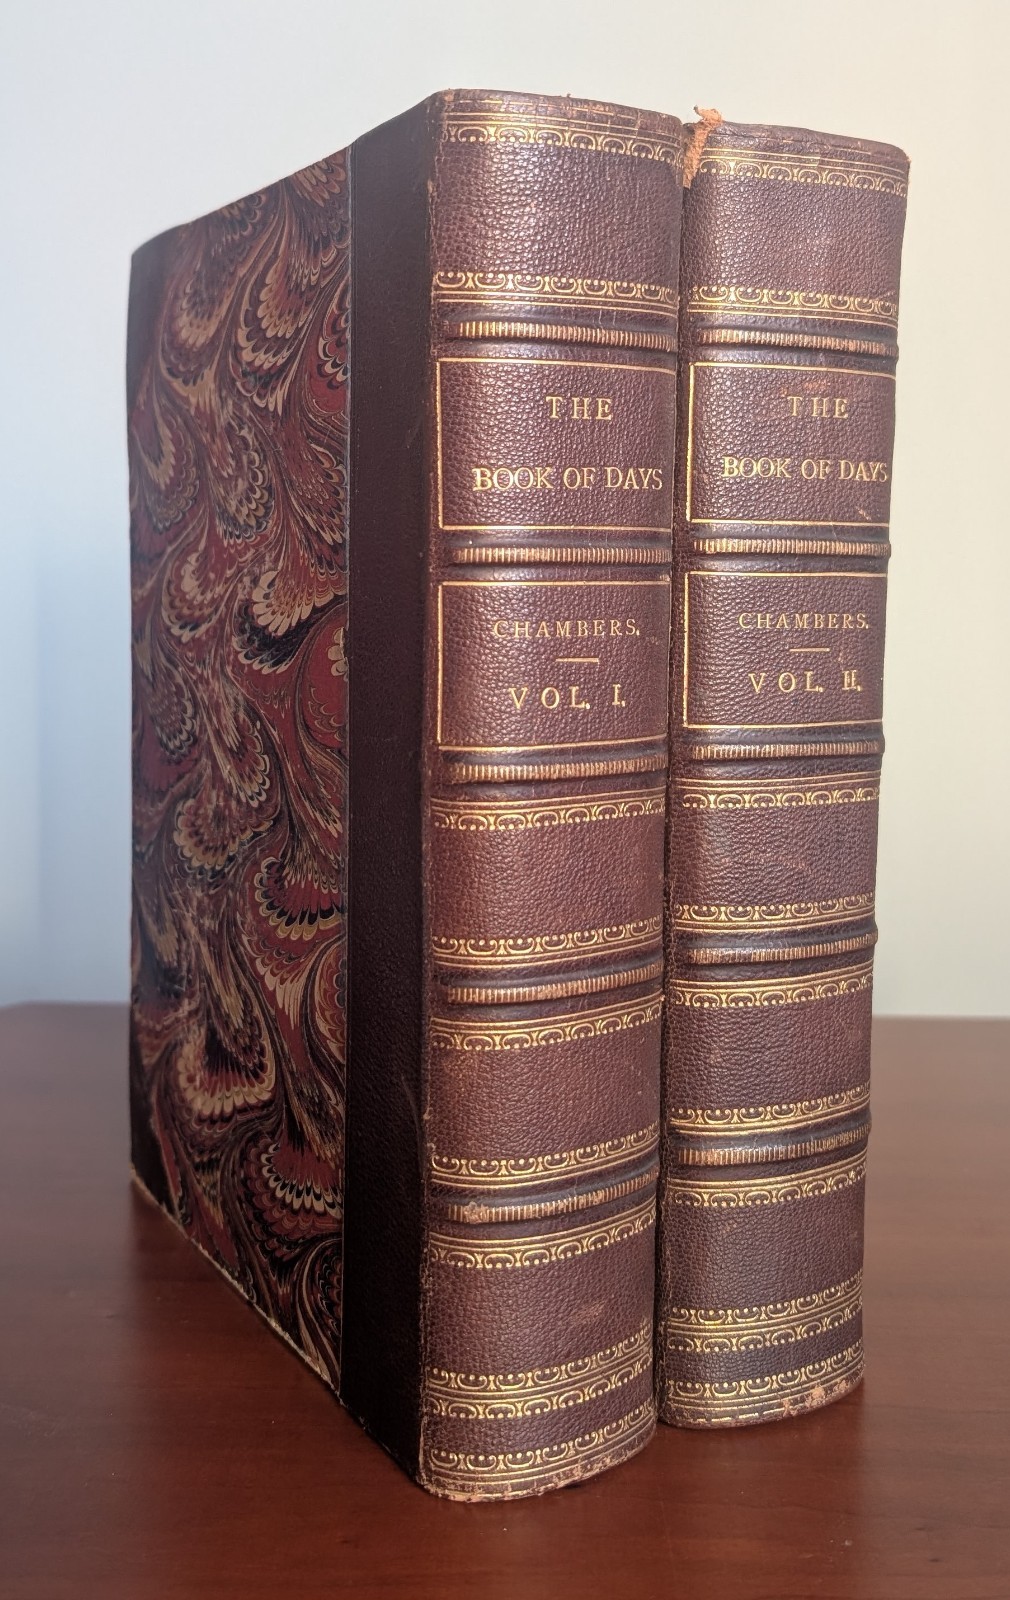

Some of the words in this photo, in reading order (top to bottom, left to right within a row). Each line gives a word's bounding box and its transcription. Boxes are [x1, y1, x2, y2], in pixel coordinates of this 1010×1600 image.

[546, 396, 613, 420] THE
[787, 396, 849, 419] THE
[472, 467, 554, 492] BOOK
[563, 466, 595, 489] OF
[604, 466, 663, 490] DAYS
[721, 456, 792, 479] BOOK
[801, 458, 831, 480] OF
[838, 459, 888, 483] DAYS
[493, 618, 640, 639] CHAMBERS.
[738, 612, 869, 629] CHAMBERS.
[748, 670, 824, 694] VOL.
[508, 685, 591, 710] VOL.
[612, 684, 626, 707] I.
